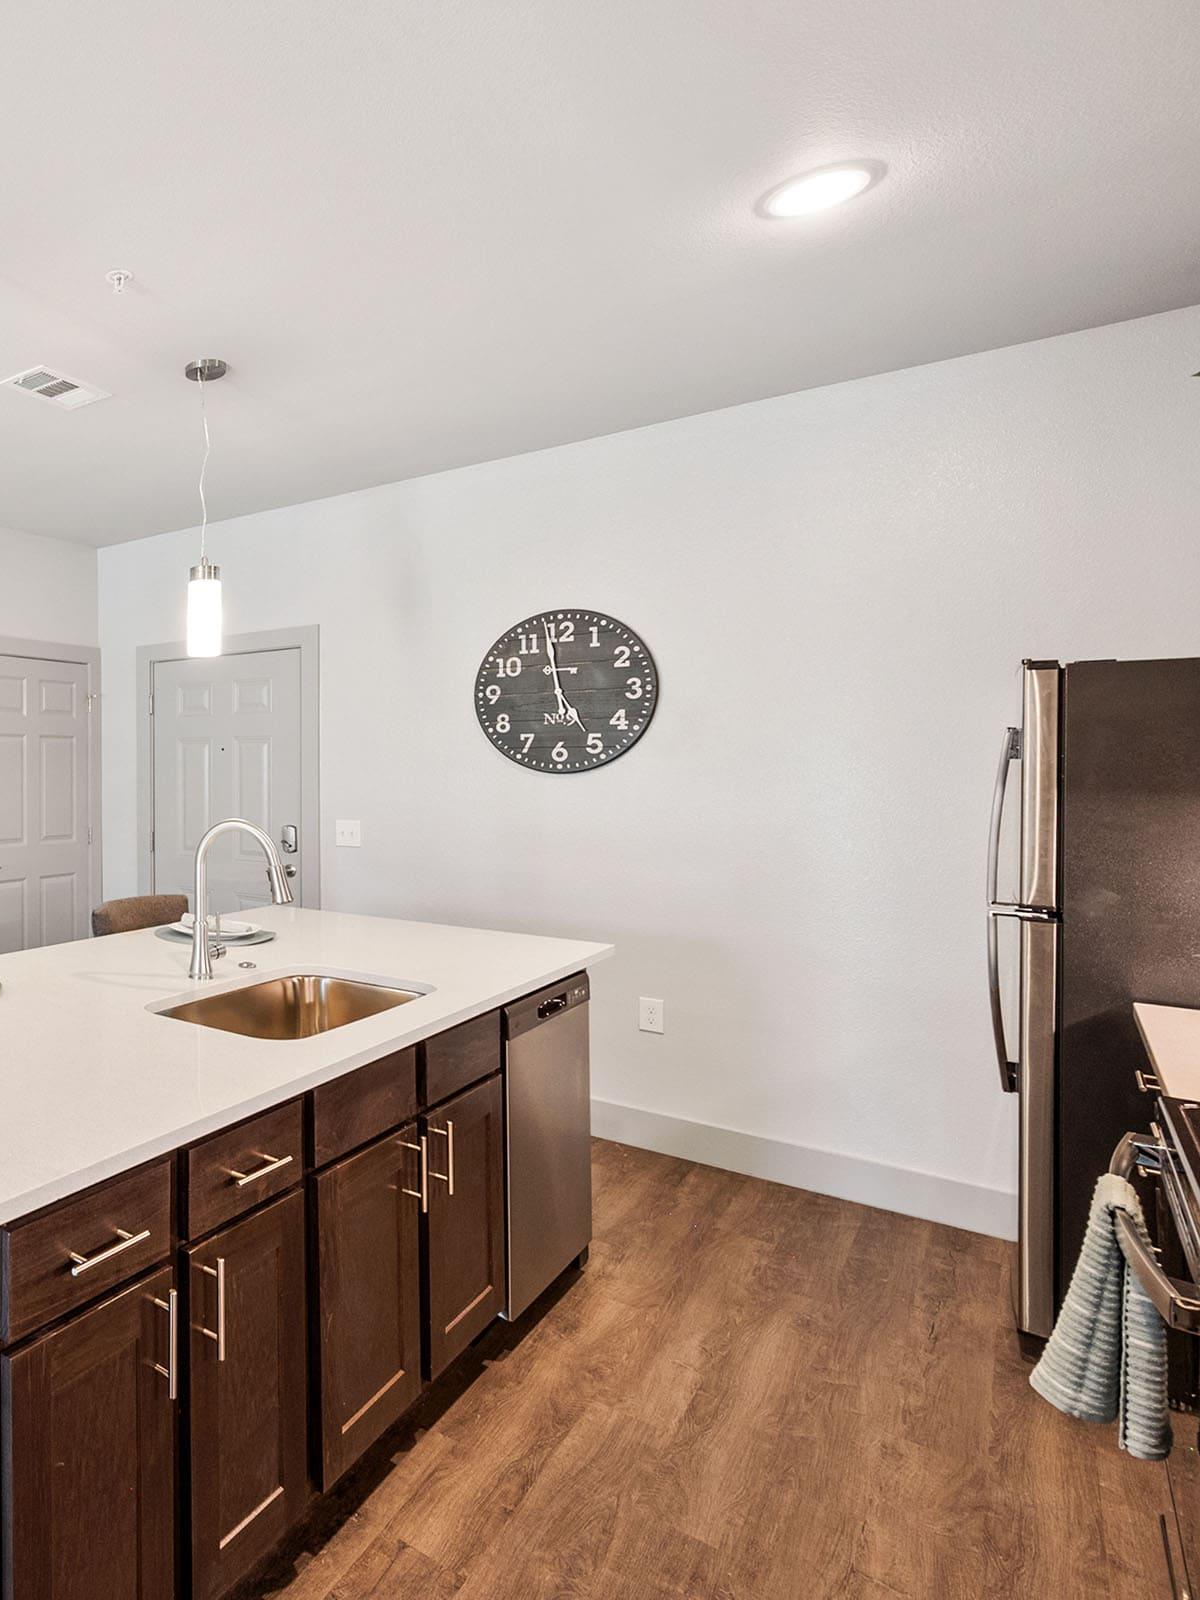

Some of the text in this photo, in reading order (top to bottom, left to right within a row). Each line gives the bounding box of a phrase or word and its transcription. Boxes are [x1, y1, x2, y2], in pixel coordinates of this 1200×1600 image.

[548, 621, 575, 643] 12
[589, 627, 600, 647] 1
[518, 634, 539, 654] 11
[614, 646, 631, 667] 2
[496, 657, 521, 677] 10
[486, 685, 500, 704] 9
[625, 678, 642, 699] 3
[496, 714, 510, 733] 8
[610, 709, 628, 730] 4
[520, 734, 534, 753] 7
[552, 742, 568, 762] 6
[586, 733, 603, 754] 5
